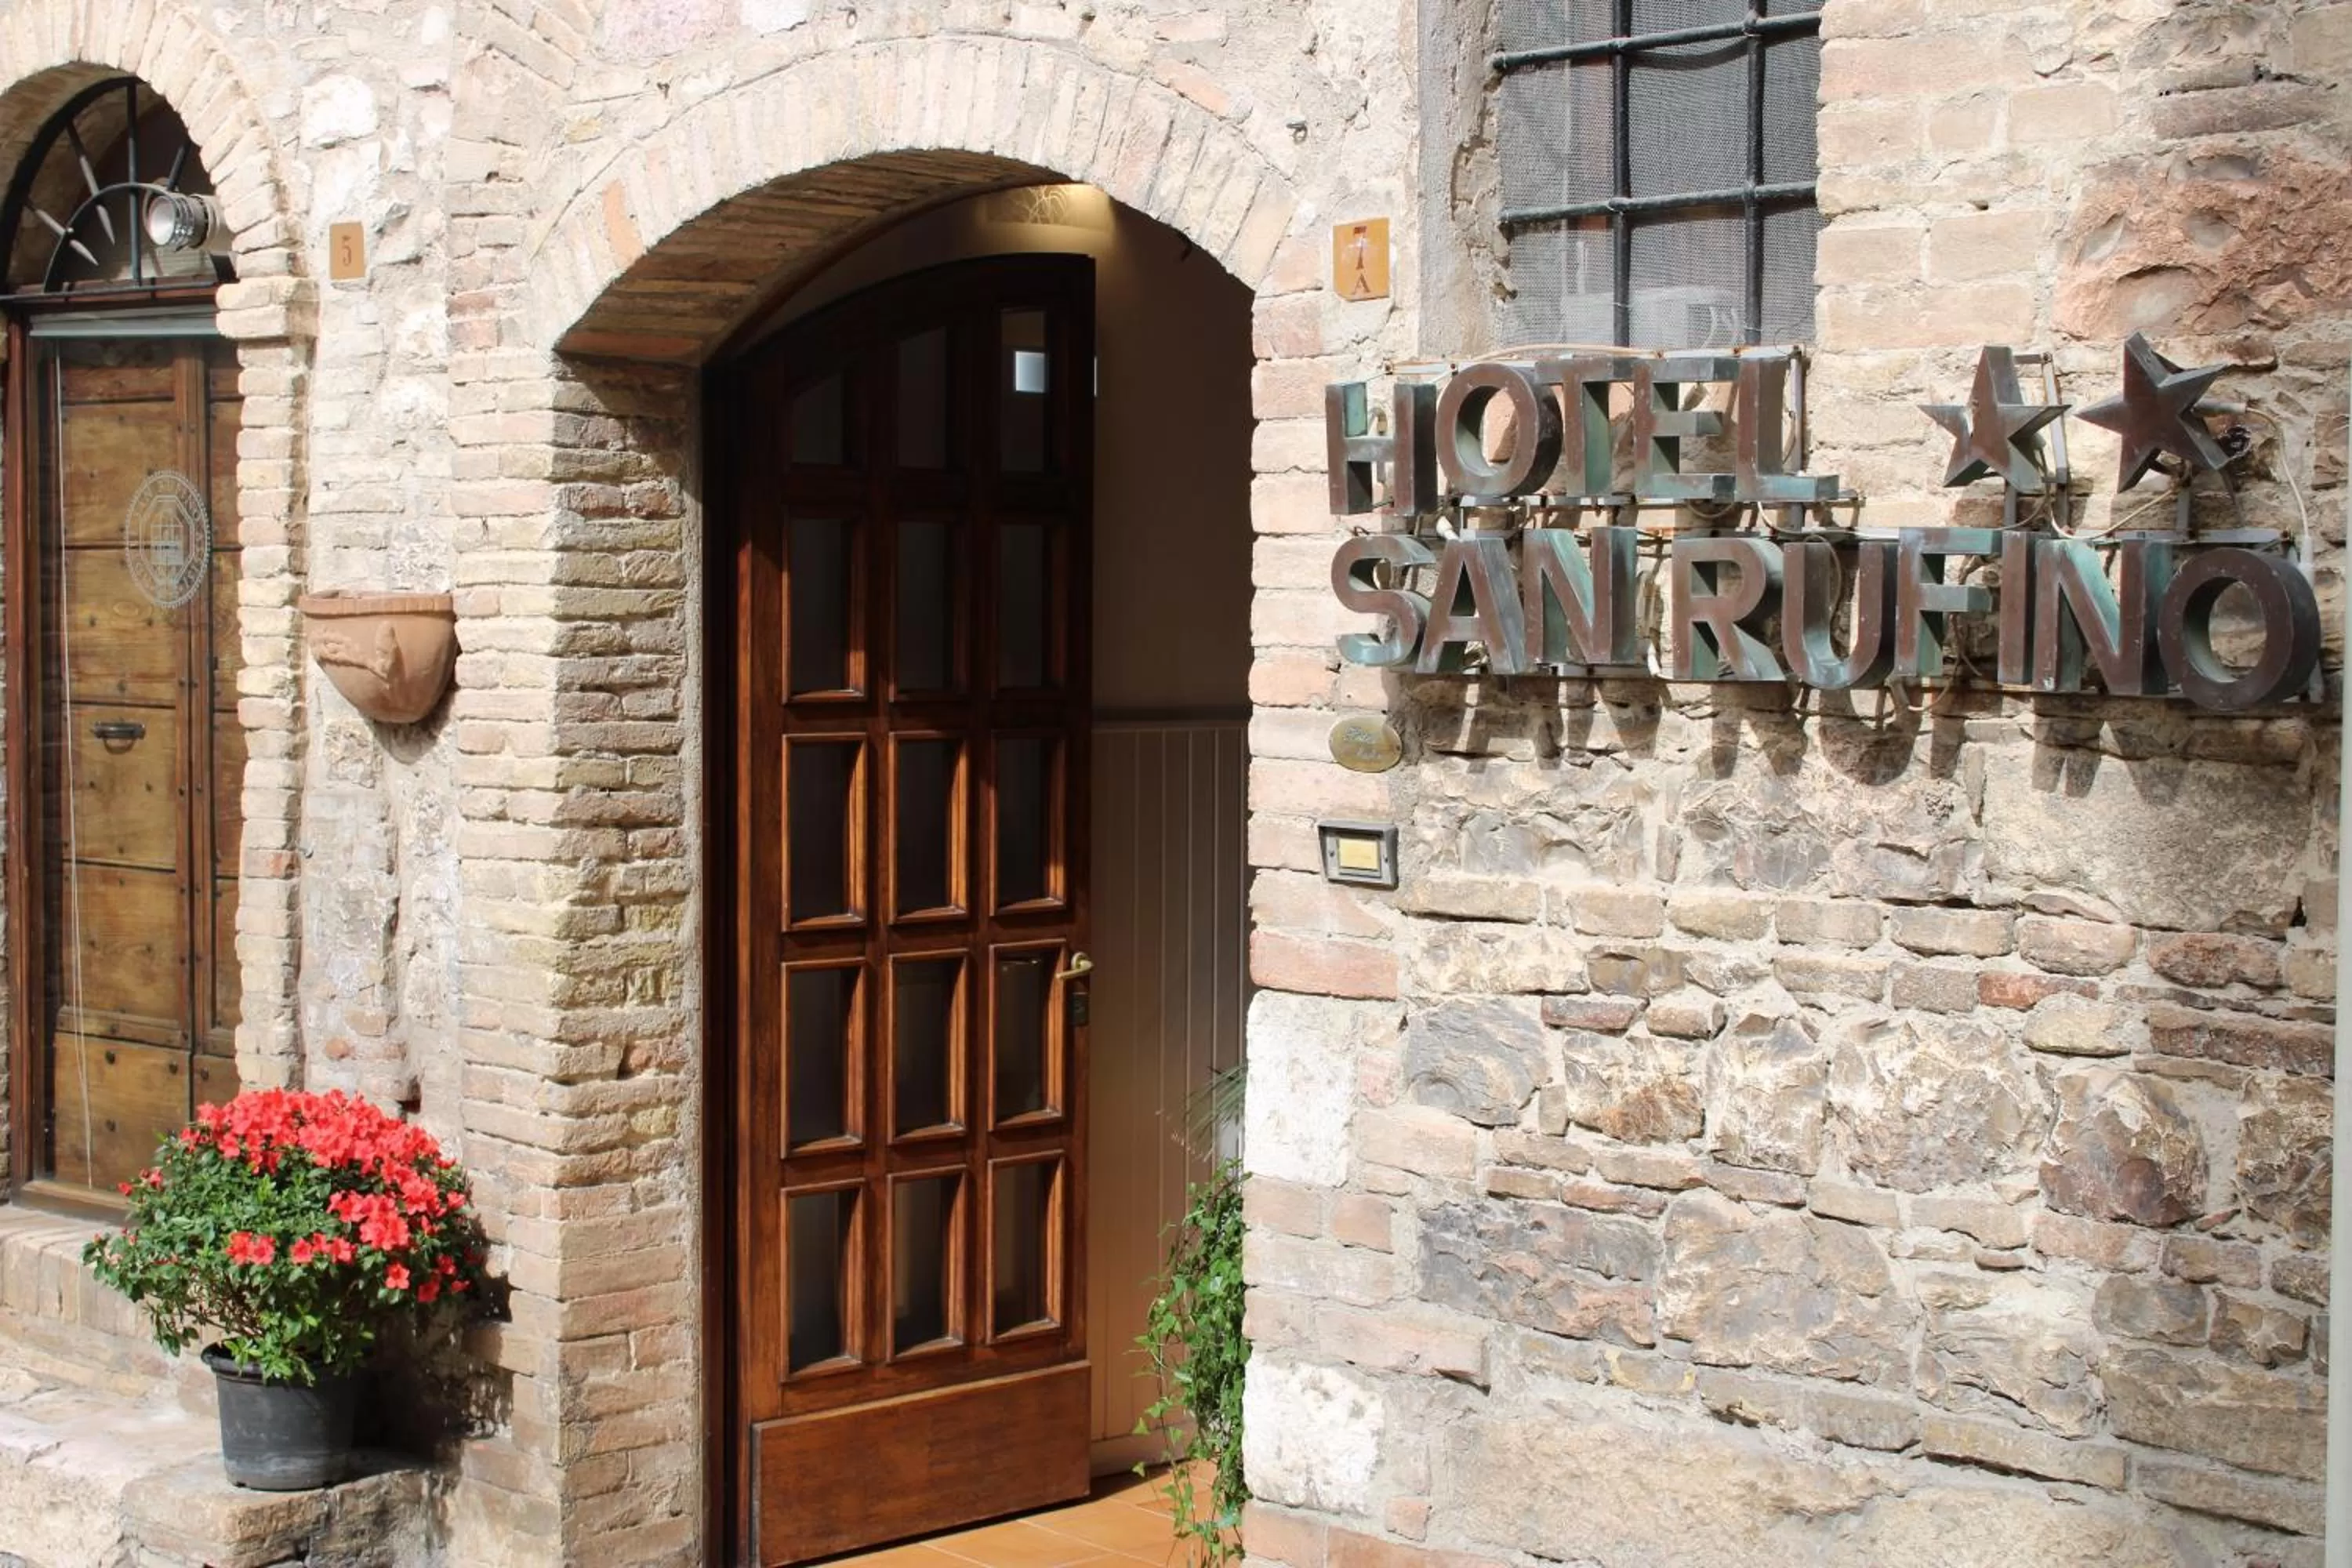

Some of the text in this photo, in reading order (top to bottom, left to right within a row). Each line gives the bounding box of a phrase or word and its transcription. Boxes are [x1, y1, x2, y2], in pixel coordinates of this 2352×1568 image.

[1326, 357, 1839, 515] HOTEL
[1330, 526, 2322, 711] SAN RUFINO
